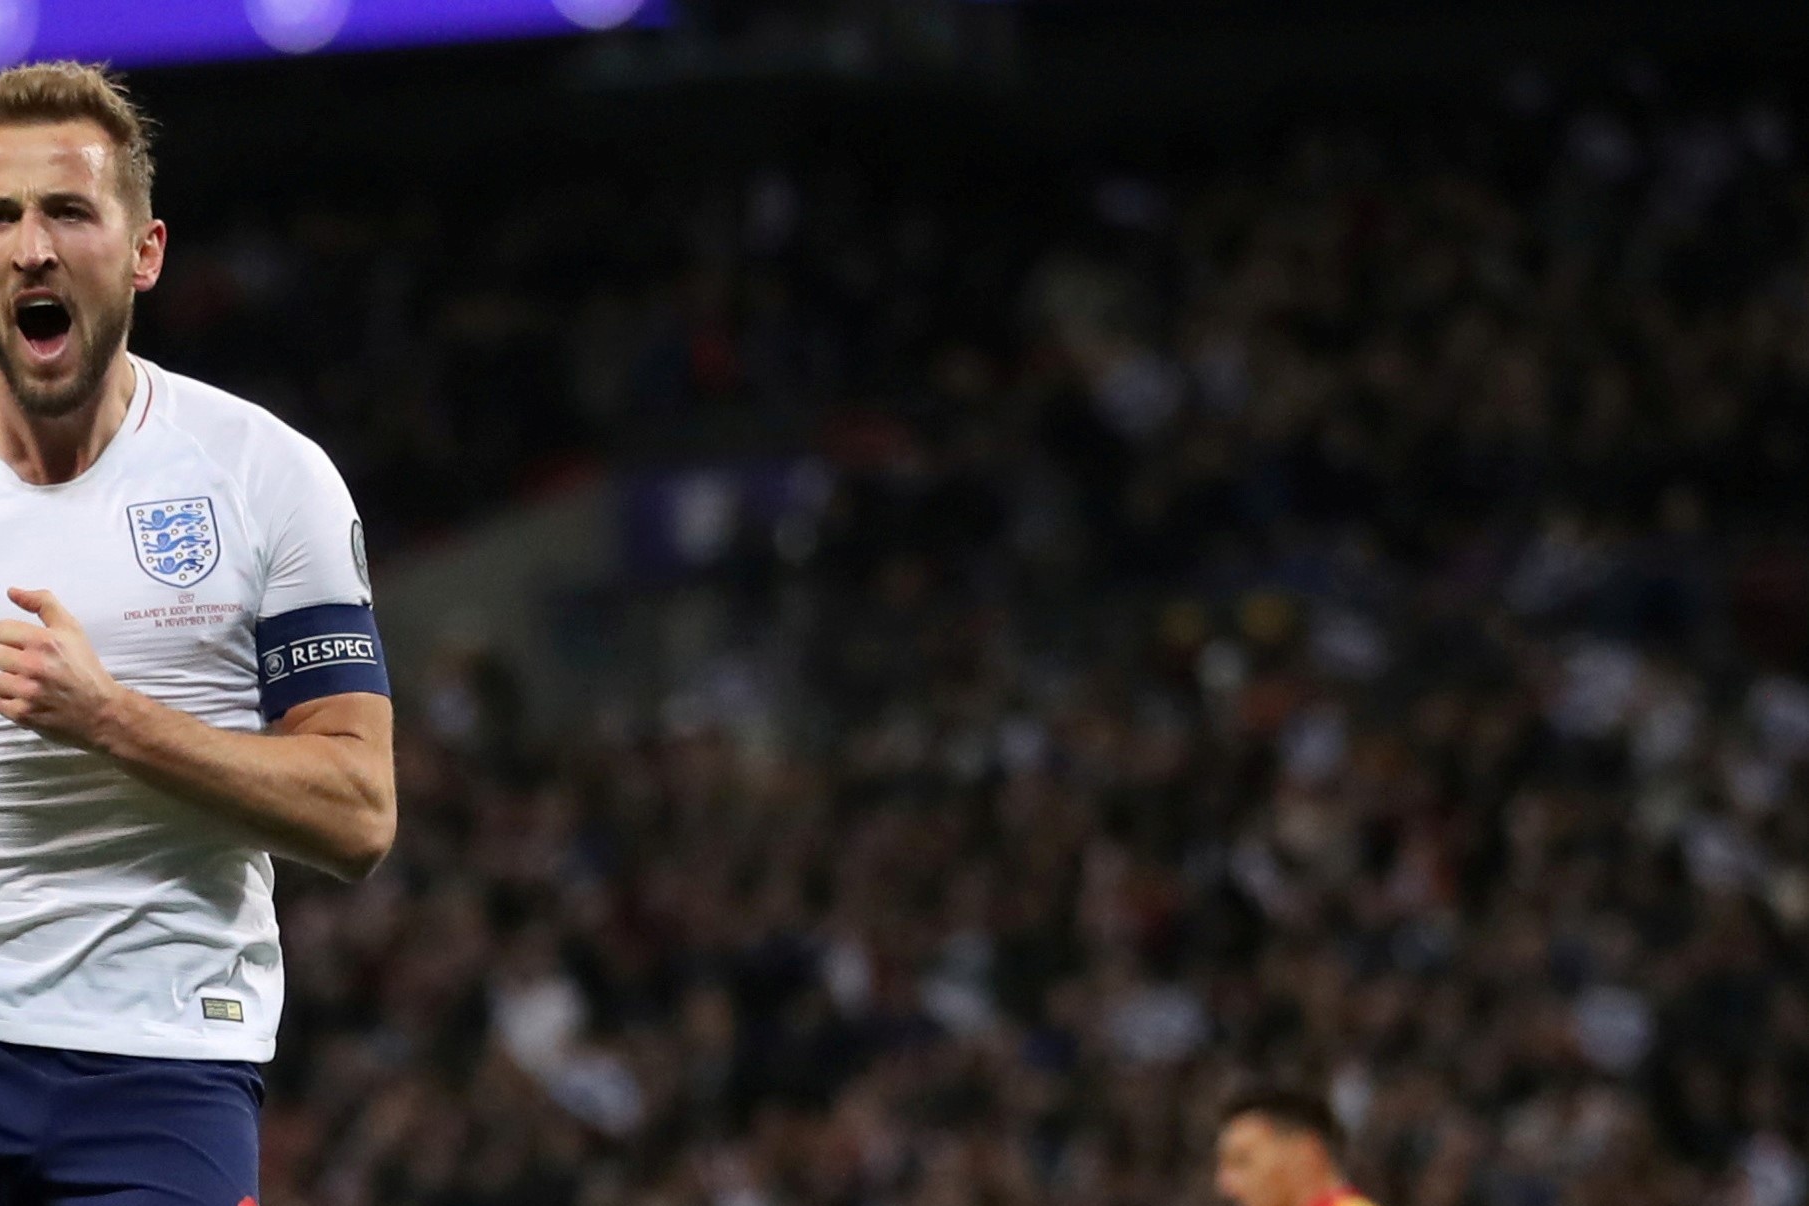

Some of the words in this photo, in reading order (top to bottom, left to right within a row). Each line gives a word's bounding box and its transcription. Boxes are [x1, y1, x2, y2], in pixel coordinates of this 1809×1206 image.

[195, 603, 244, 614] INTERNATIONA
[164, 616, 206, 627] NOVEMBER
[292, 640, 374, 666] RESPECT
